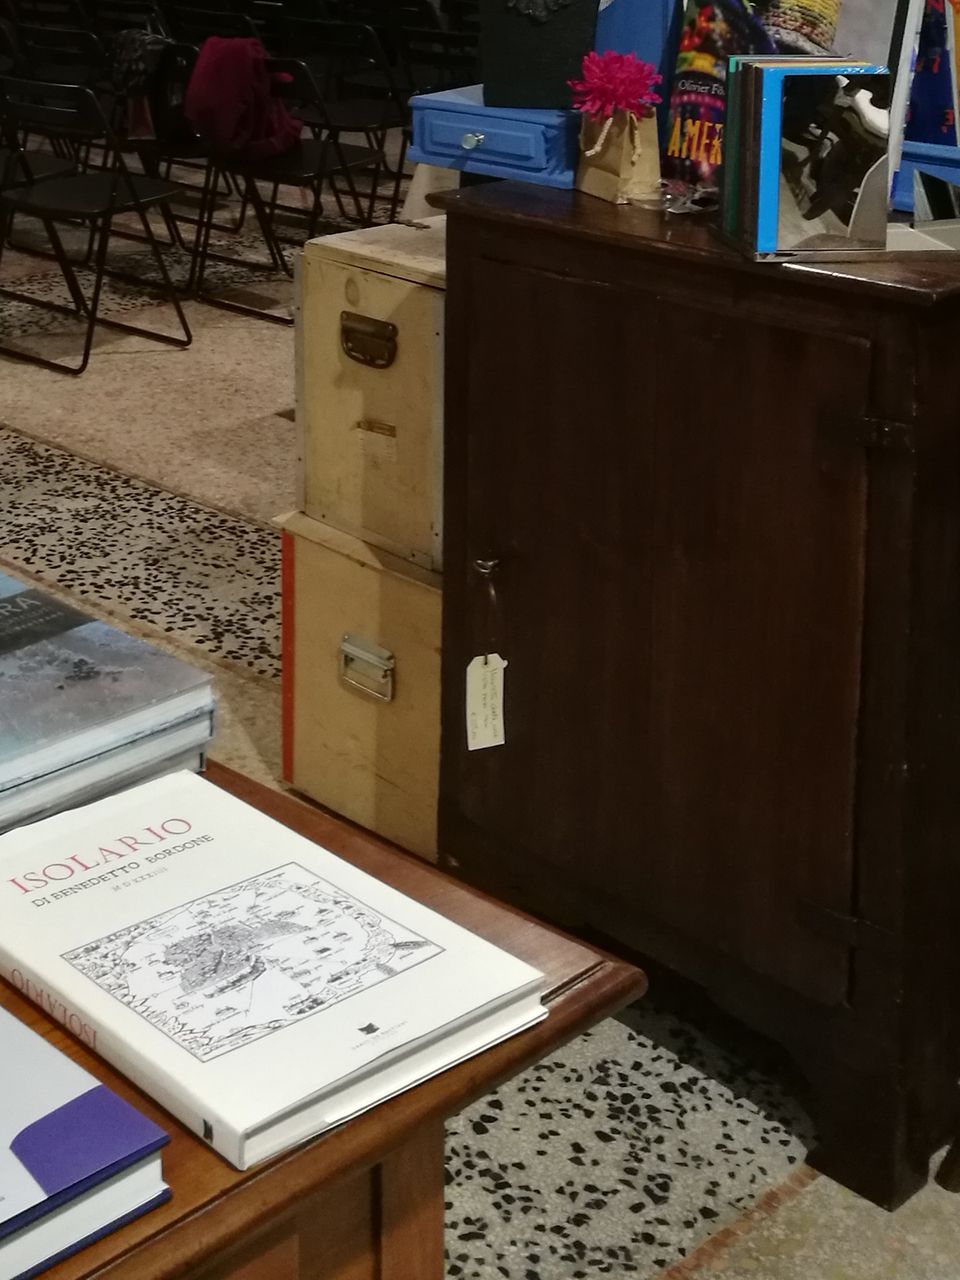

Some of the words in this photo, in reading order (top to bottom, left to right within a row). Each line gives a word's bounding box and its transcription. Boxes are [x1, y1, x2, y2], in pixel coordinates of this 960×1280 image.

[8, 818, 192, 894] ISOLARIO
[32, 896, 50, 908] DI
[51, 861, 141, 901] BENEDETTO
[144, 834, 216, 865] BORDONE
[10, 968, 98, 1050] ISOLARIO
